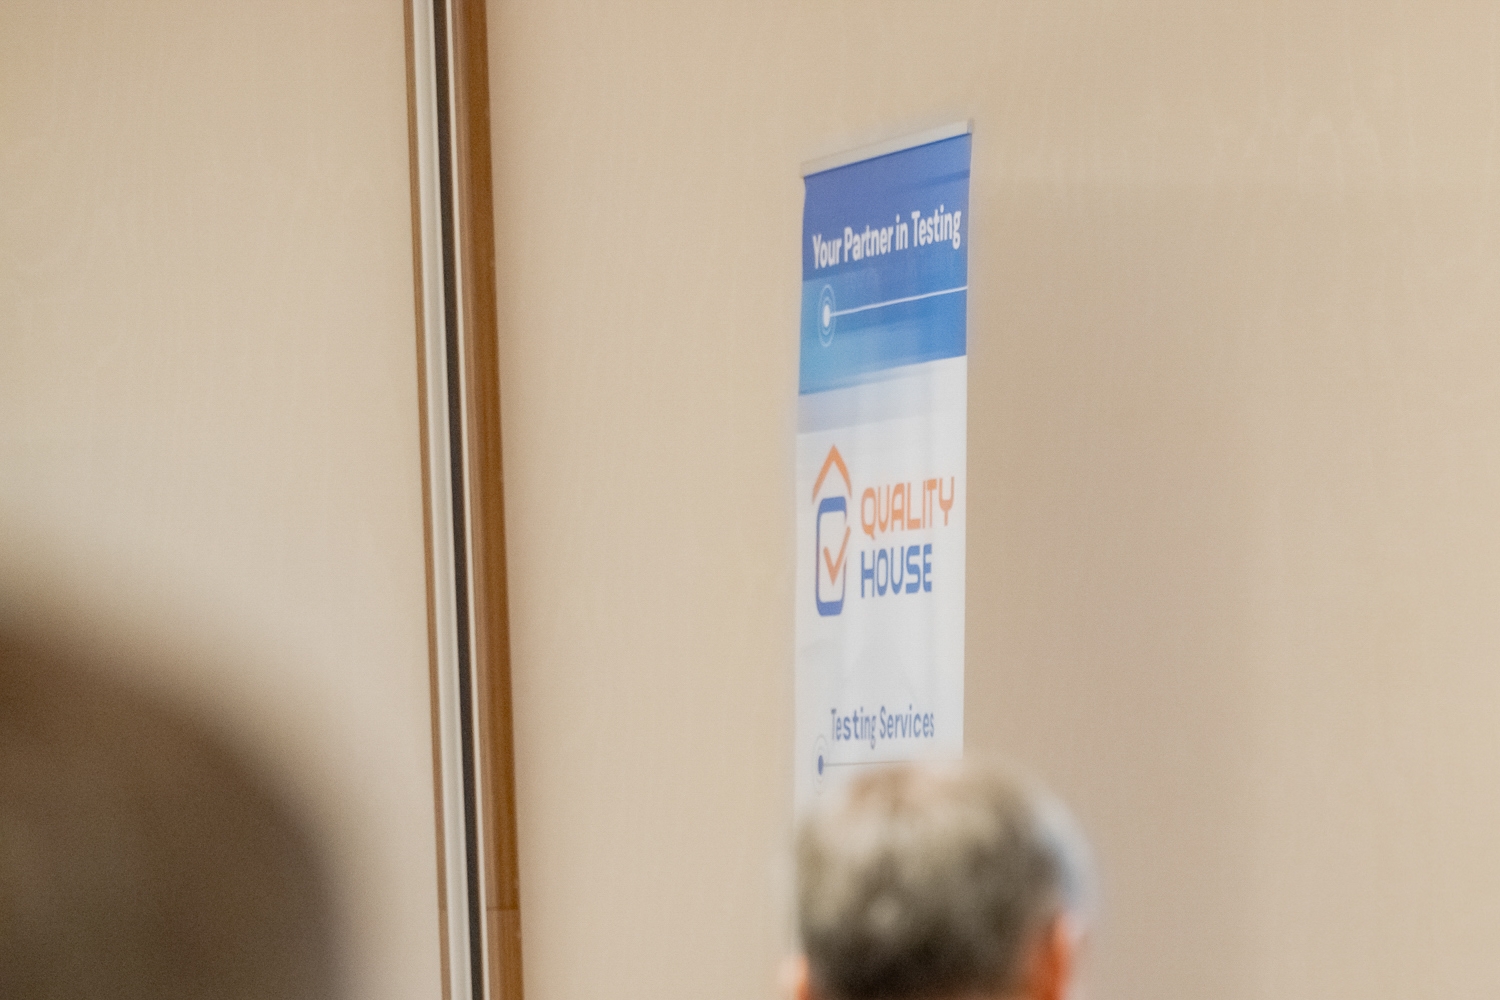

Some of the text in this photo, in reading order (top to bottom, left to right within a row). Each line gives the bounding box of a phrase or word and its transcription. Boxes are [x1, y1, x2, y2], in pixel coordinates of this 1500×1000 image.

[812, 204, 962, 270] Your Partner in Testing
[860, 476, 955, 541] QUALITY
[860, 543, 933, 599] HOUSE
[831, 704, 935, 750] Testing Services
